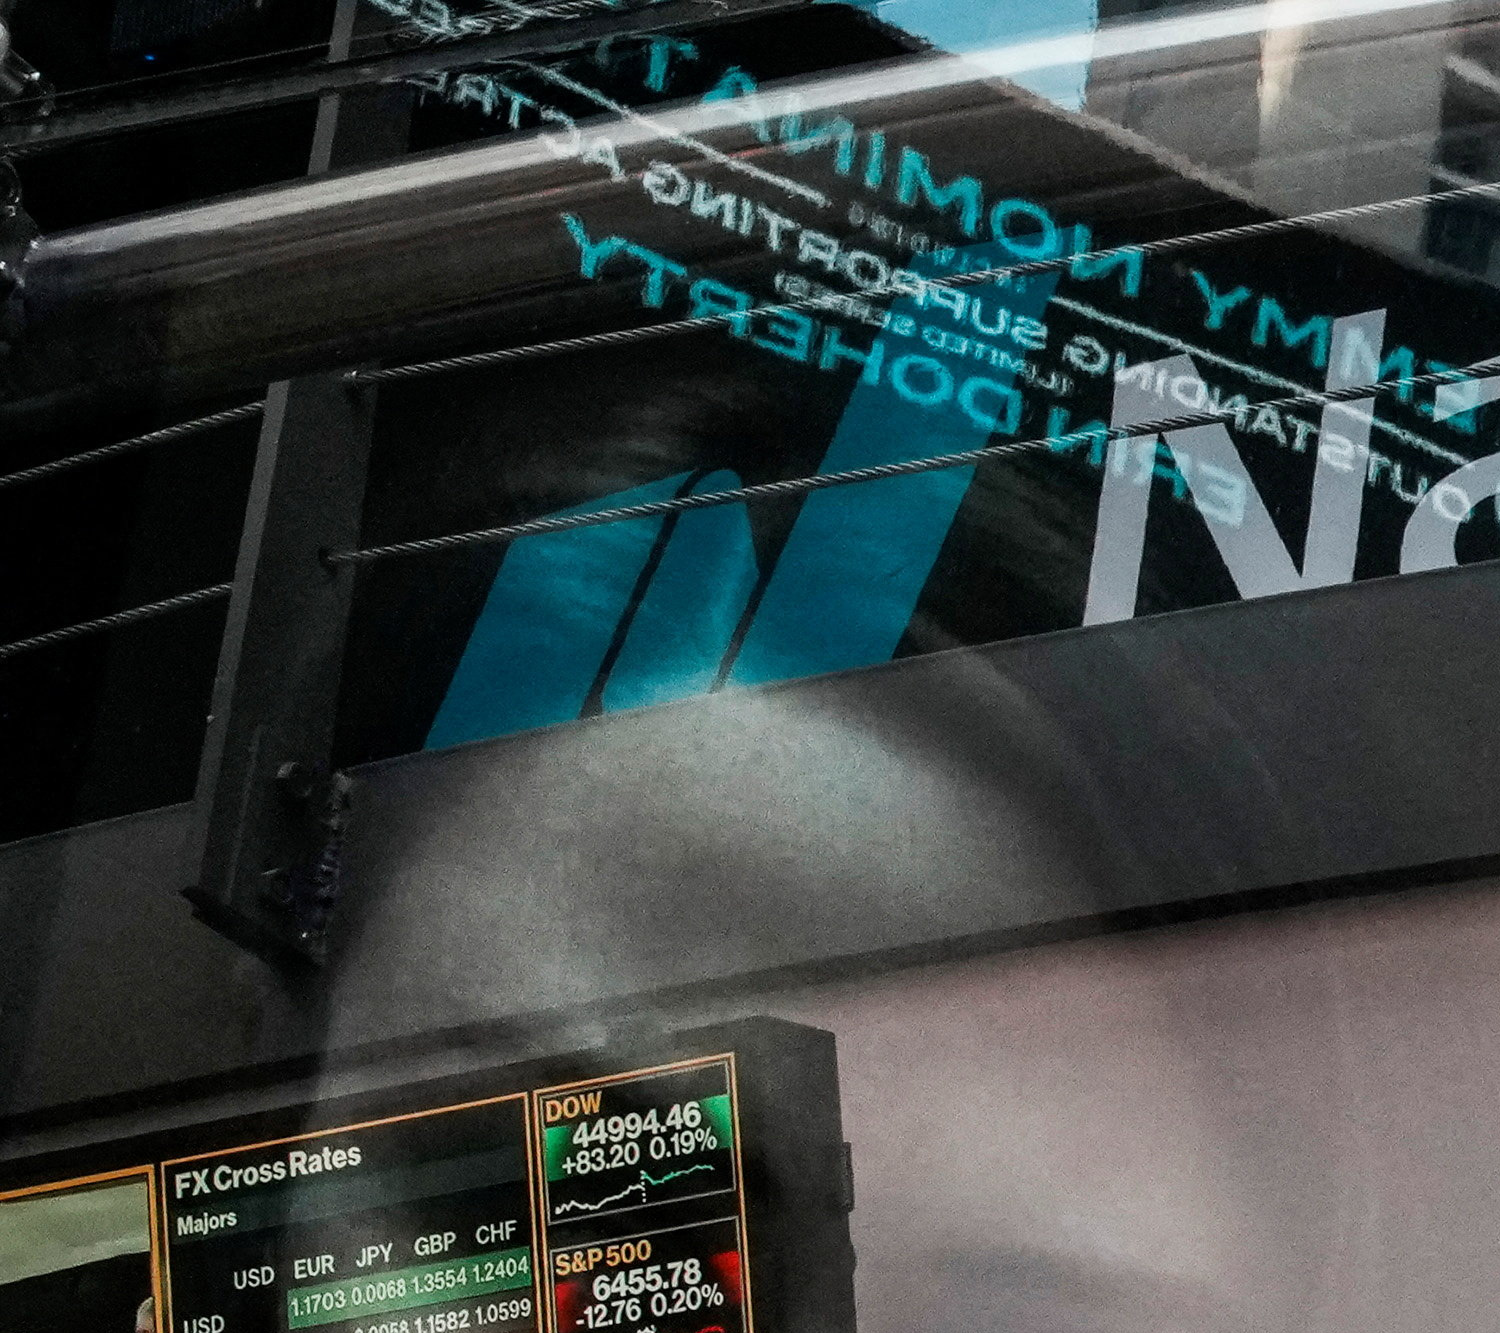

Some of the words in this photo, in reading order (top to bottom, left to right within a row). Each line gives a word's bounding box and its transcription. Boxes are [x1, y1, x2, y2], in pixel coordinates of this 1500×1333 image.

[545, 1091, 602, 1122] DOW
[571, 1100, 702, 1149] 44994.46
[175, 1168, 210, 1199] FX
[214, 1155, 286, 1192] Cross
[289, 1140, 361, 1178] Rates
[561, 1141, 640, 1178] +83.20
[649, 1126, 717, 1161] 0.19%
[177, 1206, 237, 1237] Majors
[233, 1265, 275, 1290] USD
[293, 1253, 334, 1279] EUR
[355, 1242, 393, 1267] JPY
[413, 1231, 457, 1257] GBP
[475, 1219, 517, 1245] CHF
[555, 1246, 606, 1276] S&P
[607, 1238, 651, 1267] 500
[291, 1290, 346, 1317] 1.1703
[351, 1279, 406, 1306] 0.0068
[412, 1267, 468, 1295] 1.3554
[472, 1256, 529, 1284] 1.2404
[591, 1257, 702, 1302] 6455.78
[475, 1298, 531, 1326] 1.0599
[574, 1297, 641, 1331] -12.76
[651, 1282, 724, 1318] 0.20%
